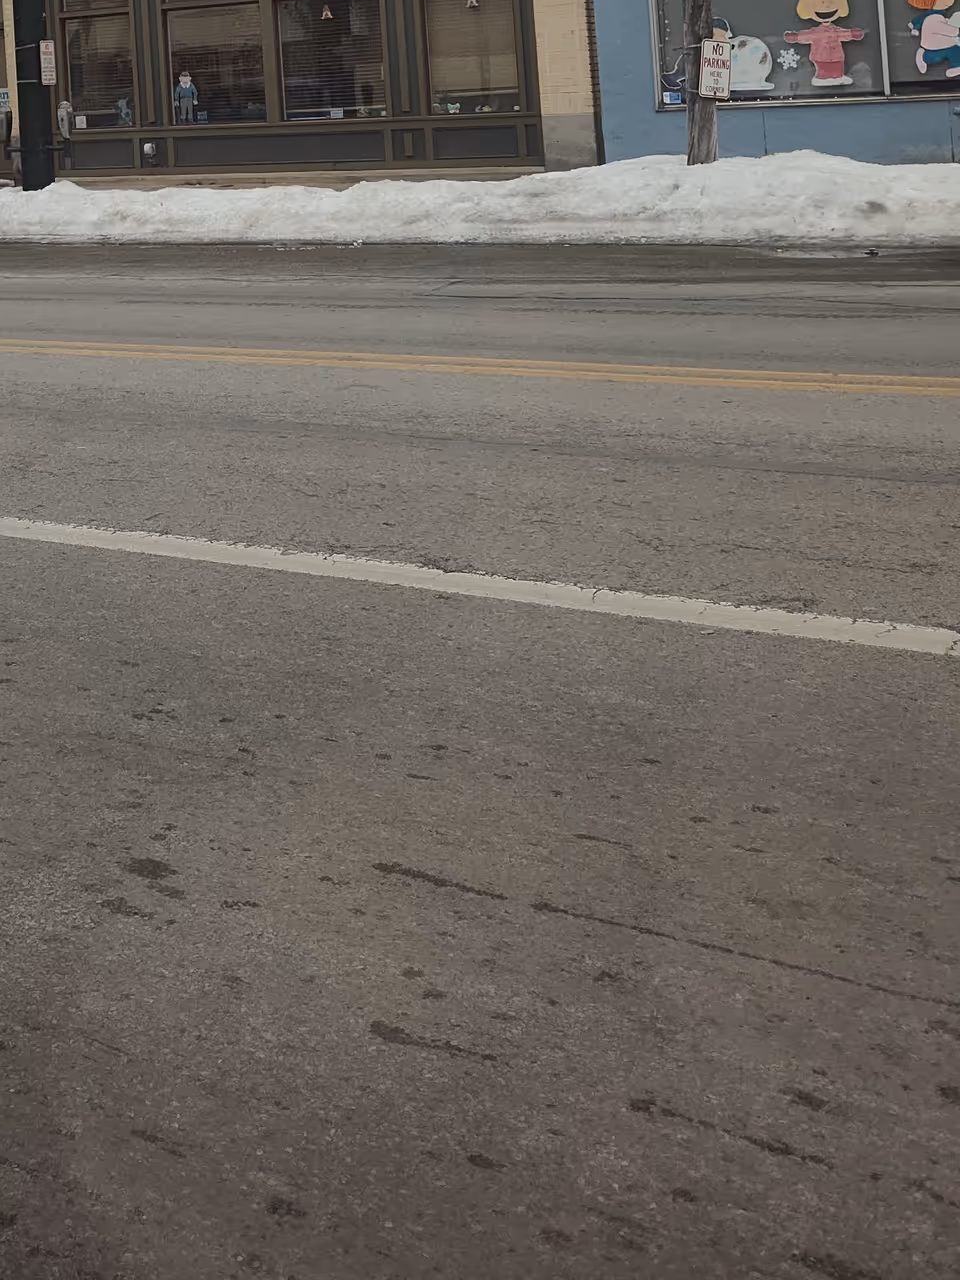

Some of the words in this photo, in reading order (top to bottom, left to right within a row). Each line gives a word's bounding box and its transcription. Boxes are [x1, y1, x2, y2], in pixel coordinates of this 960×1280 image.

[712, 44, 724, 56] NO
[704, 57, 730, 70] PARKING
[710, 71, 723, 79] HERE
[705, 86, 725, 94] CORNER
